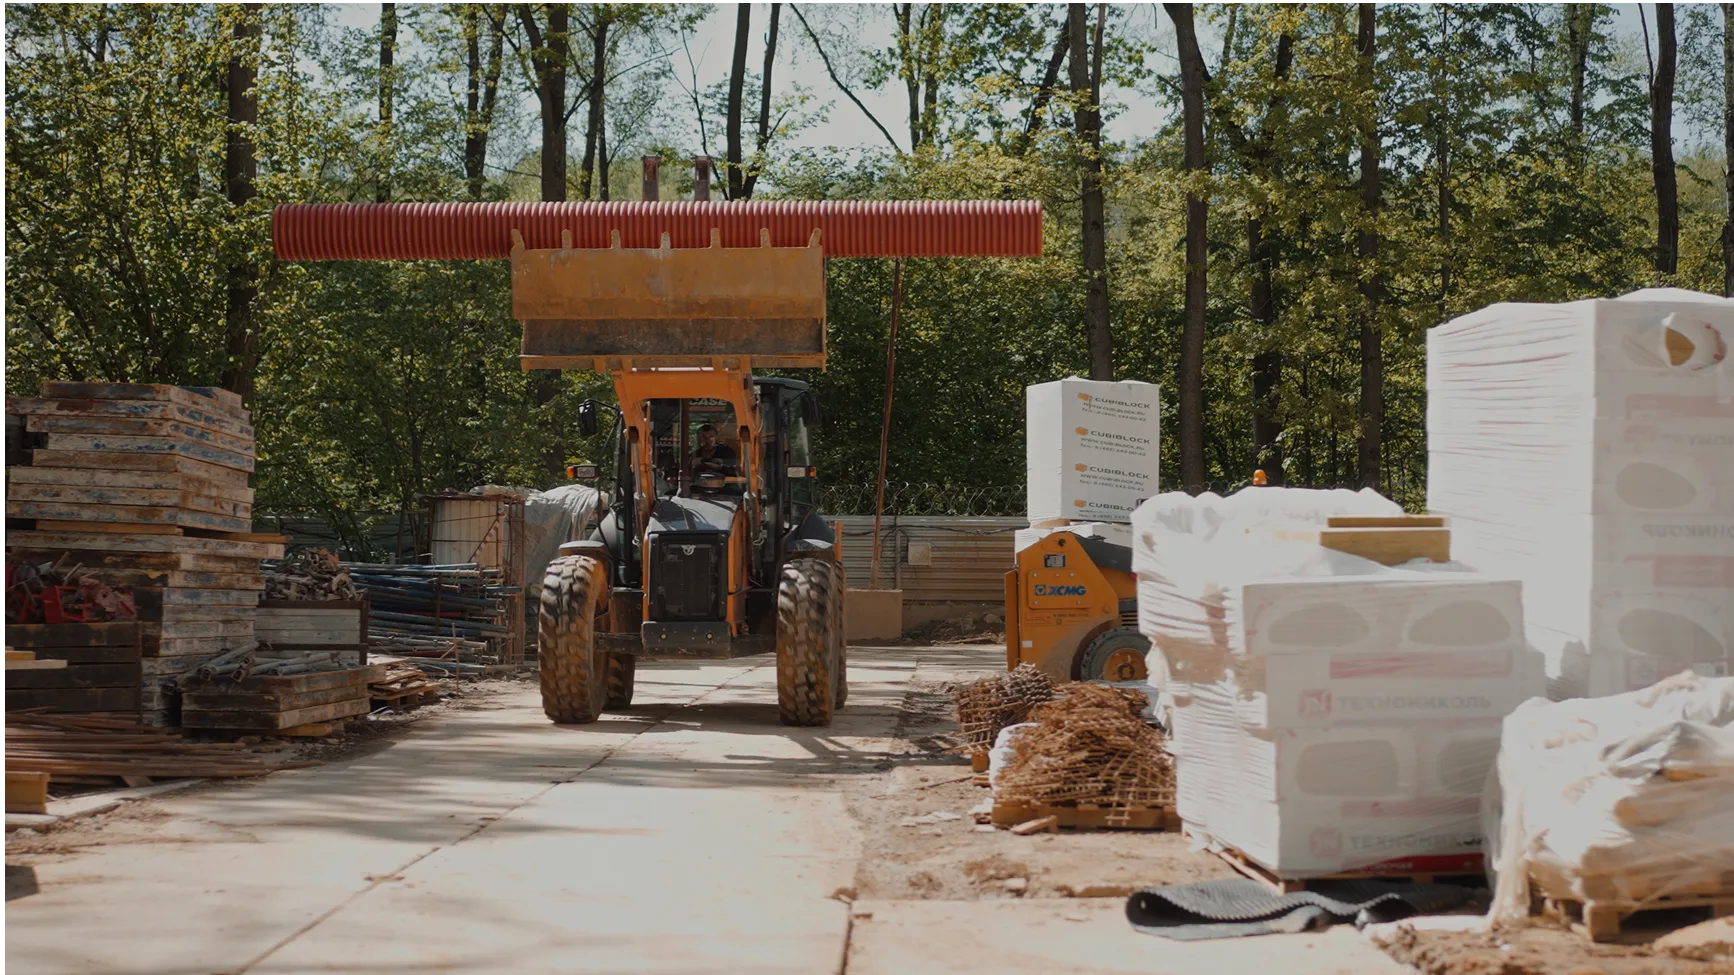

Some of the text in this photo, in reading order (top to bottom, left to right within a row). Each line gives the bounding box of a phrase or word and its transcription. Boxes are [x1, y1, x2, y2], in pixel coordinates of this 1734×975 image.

[688, 398, 727, 406] CASE
[1095, 397, 1151, 409] CUBIBLOCK
[1090, 430, 1151, 444] CUBIBLOCK
[1089, 466, 1149, 479] CUBIBLOCK
[1088, 502, 1134, 512] CUBIBLO
[1641, 524, 1734, 539] ОНИКОЛЬ
[1048, 586, 1087, 596] XCMG
[1336, 695, 1493, 711] ТЕХНОНИКОЛЬ
